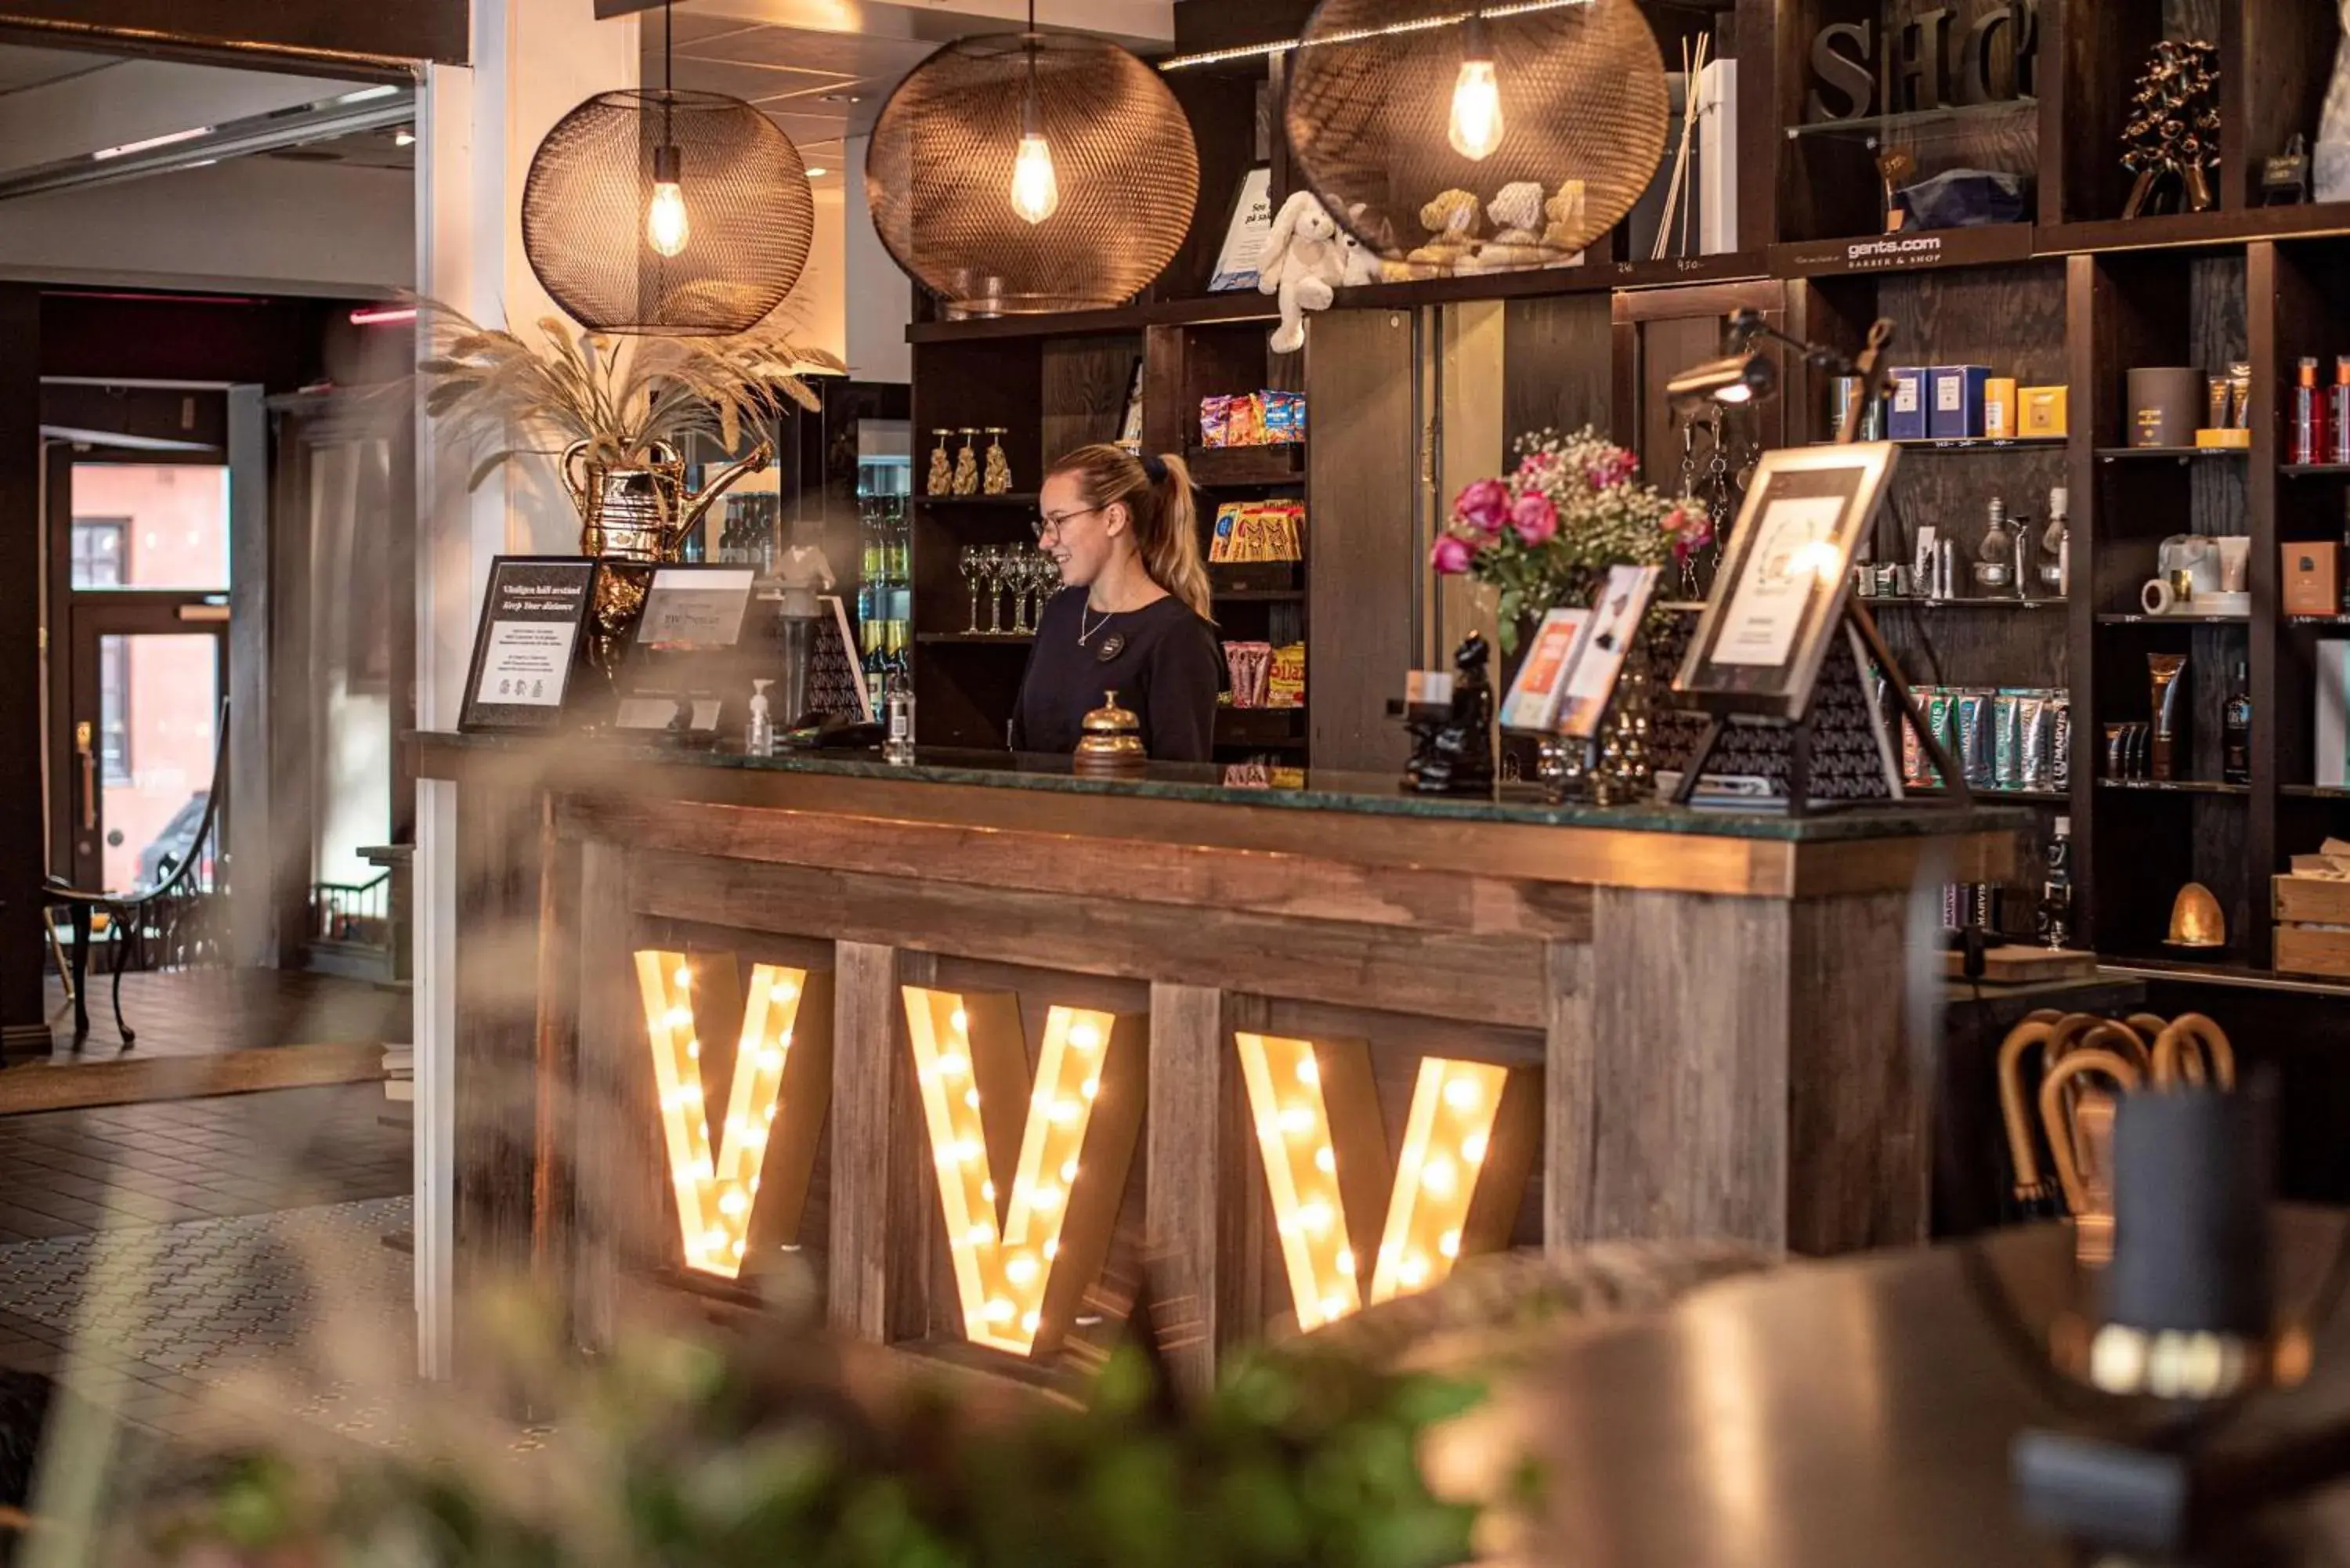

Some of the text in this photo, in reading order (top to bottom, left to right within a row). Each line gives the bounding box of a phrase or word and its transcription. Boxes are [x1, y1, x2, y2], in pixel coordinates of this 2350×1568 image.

[1848, 237, 1940, 259] gents.com
[1849, 258, 1891, 269] BARBER
[1910, 254, 1941, 262] SHOP
[1932, 707, 1943, 739] RVIS
[2054, 710, 2066, 761] MARVIS
[1977, 883, 1987, 927] MARVIS
